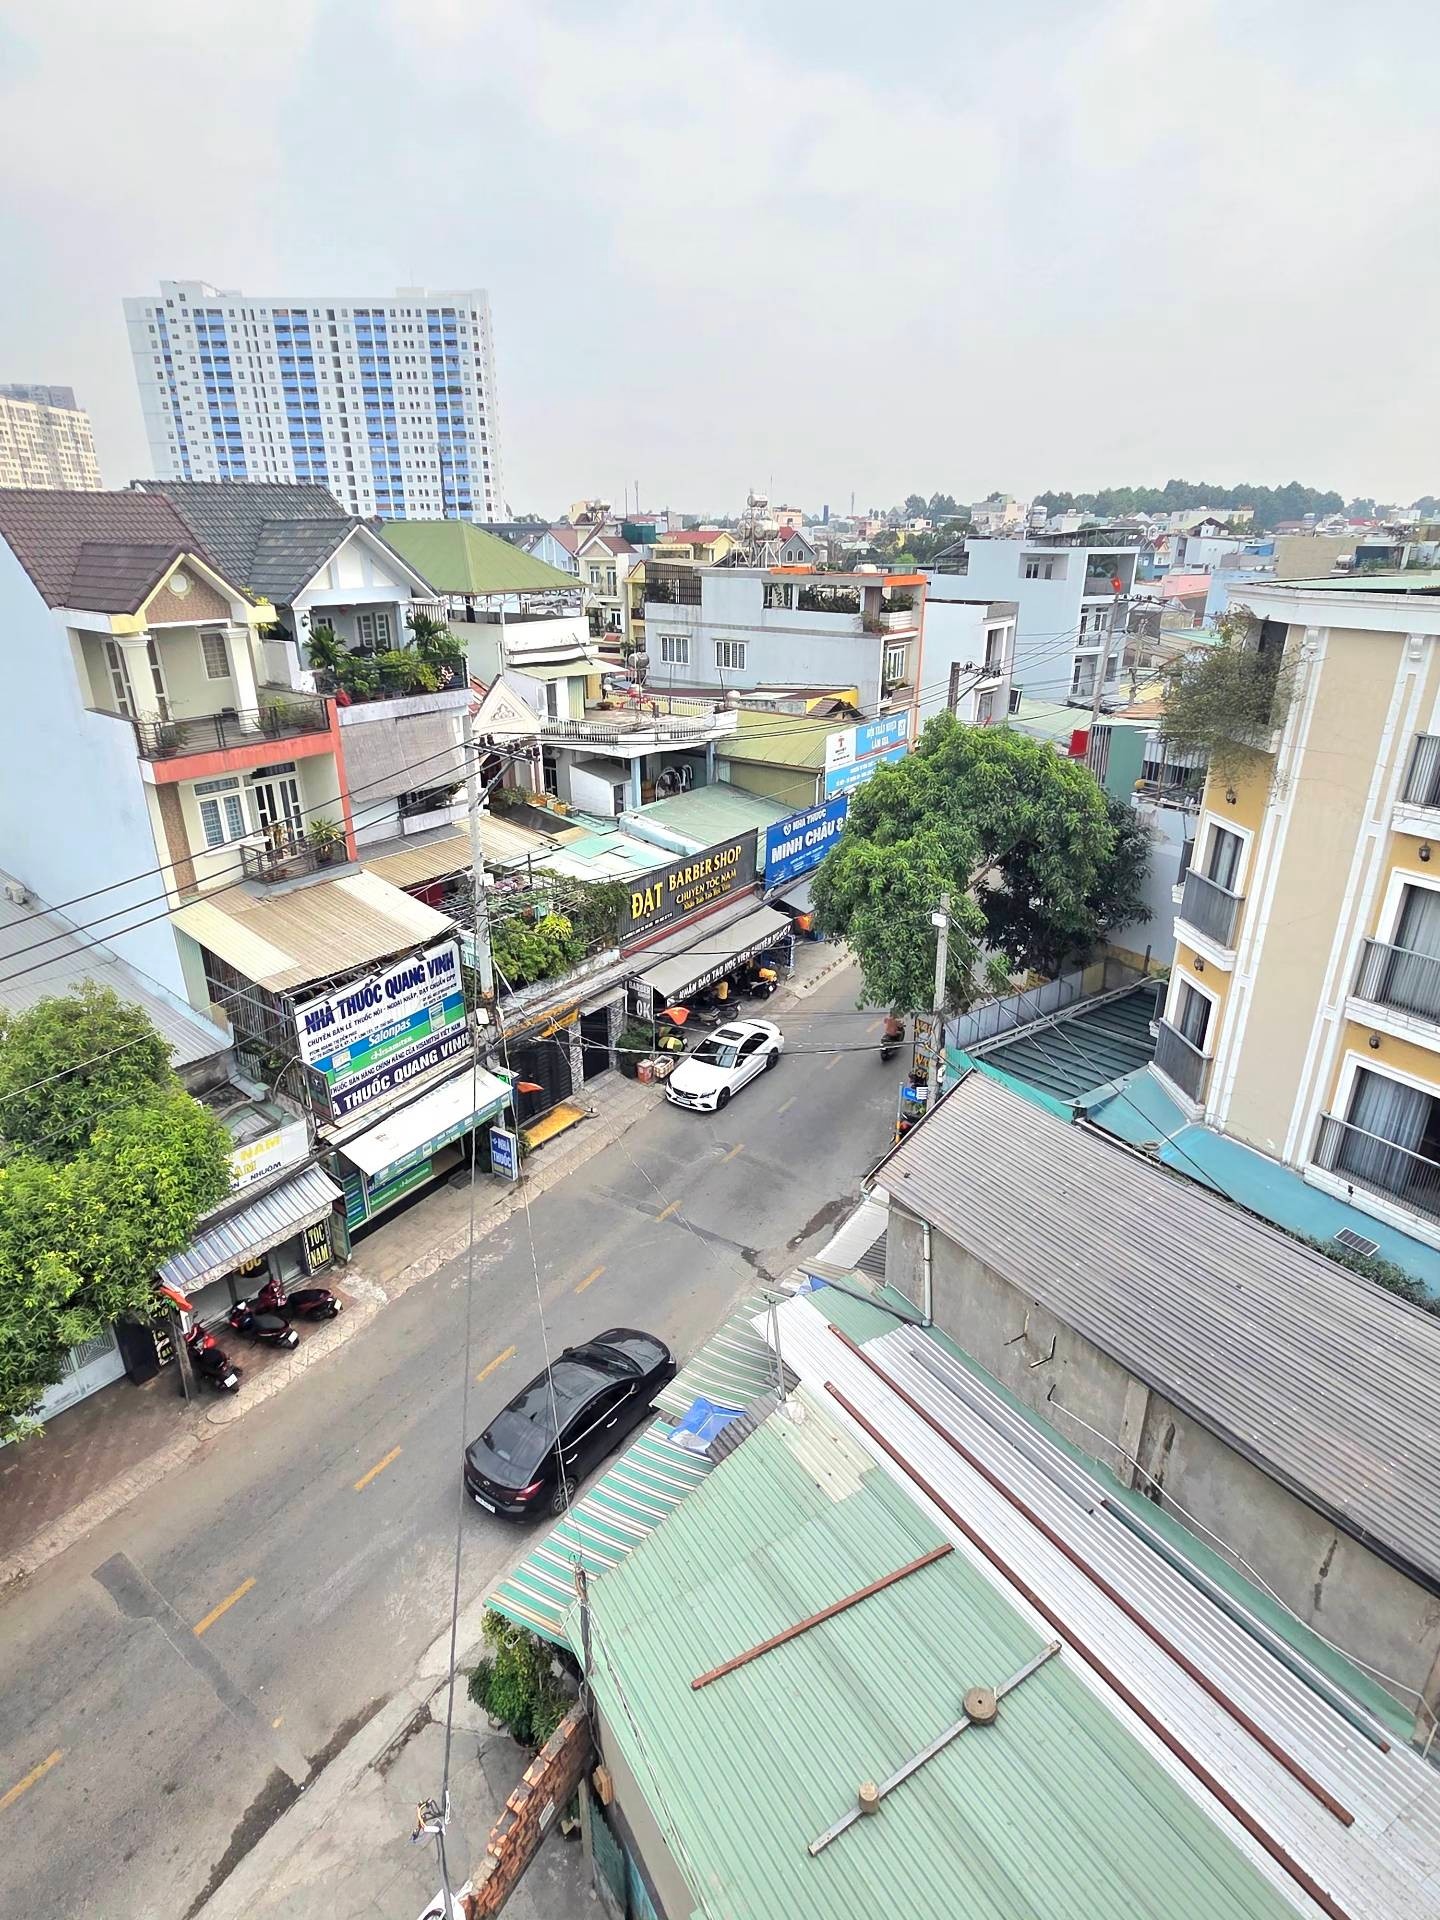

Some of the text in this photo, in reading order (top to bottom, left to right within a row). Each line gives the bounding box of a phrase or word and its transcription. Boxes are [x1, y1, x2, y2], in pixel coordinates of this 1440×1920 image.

[771, 836, 803, 863] MINH
[805, 820, 835, 846] CHÂU
[668, 845, 741, 891] BARBER SHOP
[705, 875, 720, 890] TÓC
[720, 868, 737, 882] NAM
[631, 882, 663, 919] ĐẠT
[304, 1001, 335, 1035] NHÀ
[337, 979, 382, 1020] THUỐC
[385, 964, 425, 1000] QUANG
[427, 949, 455, 978] VINH
[307, 1033, 331, 1047] CHUYÊN
[333, 1026, 345, 1036] BÁN
[354, 1012, 372, 1025] THUỐC
[367, 1018, 411, 1047] Salonpas
[343, 1075, 390, 1109] THUỐC
[393, 1049, 438, 1083] QUANG
[440, 1032, 471, 1057] VINH
[240, 1135, 281, 1160] NAM
[311, 1243, 329, 1268] NAM
